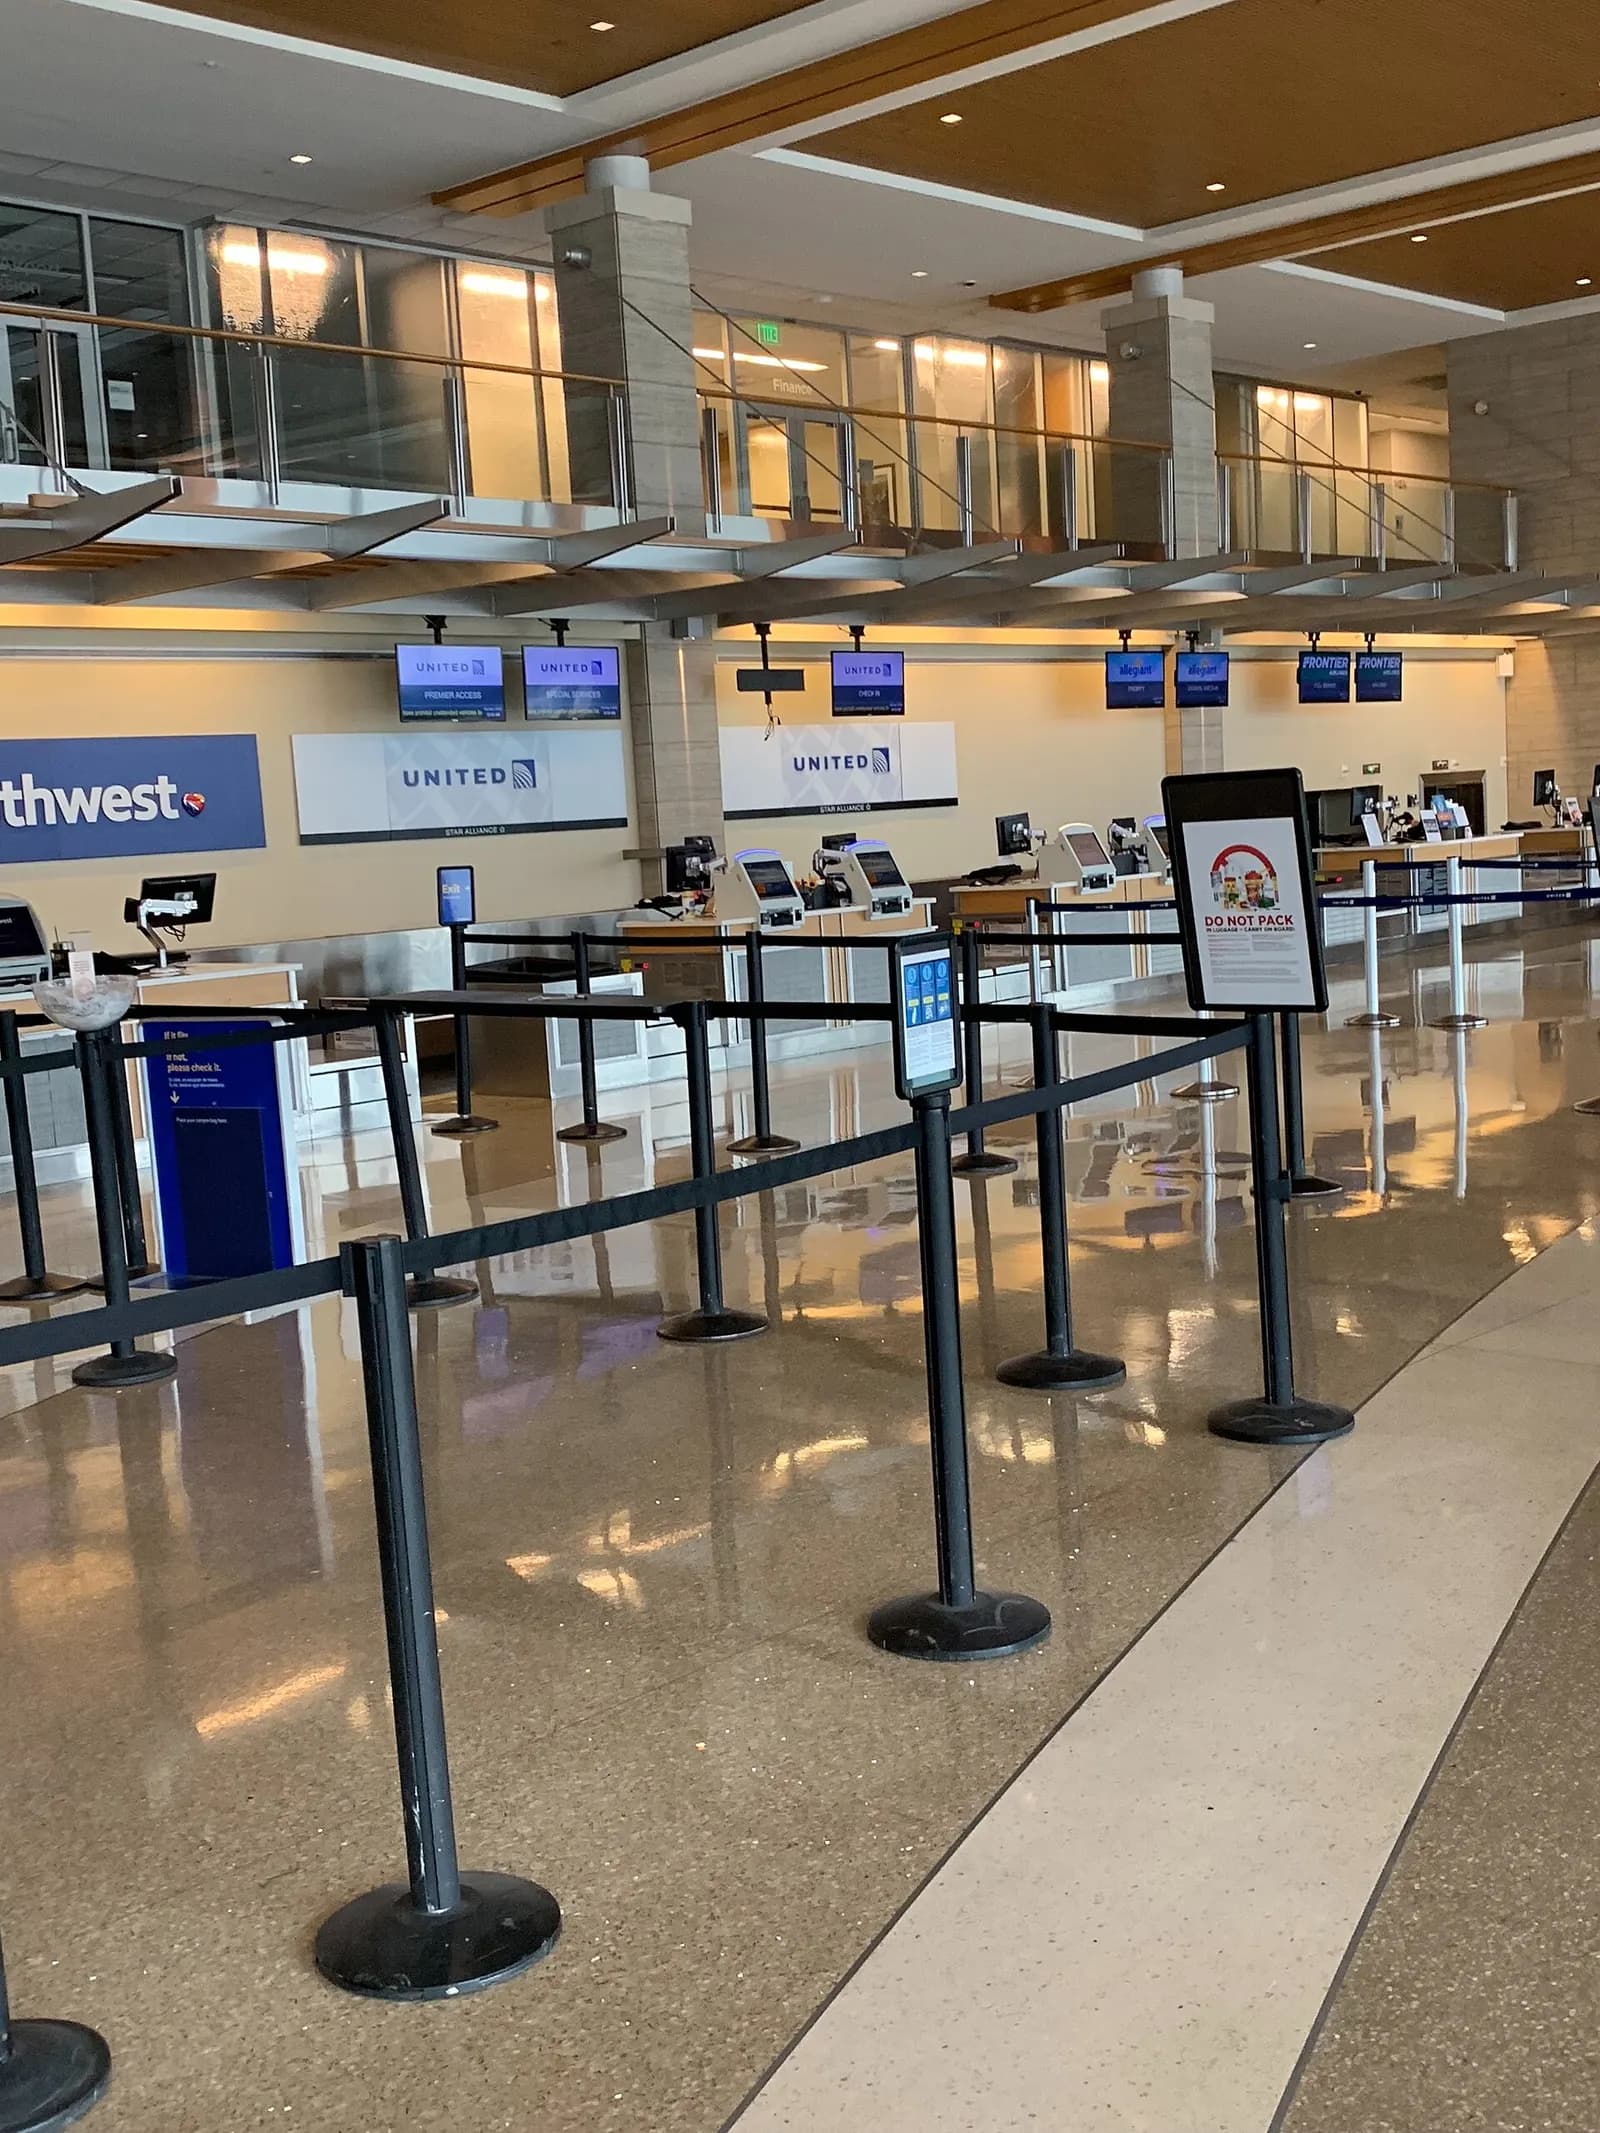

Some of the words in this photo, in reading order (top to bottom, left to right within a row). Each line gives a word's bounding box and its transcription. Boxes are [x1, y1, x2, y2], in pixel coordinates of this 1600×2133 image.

[416, 663, 469, 672] UNITED
[540, 664, 588, 672] UNITED
[1302, 656, 1349, 669] FRONTIER
[1359, 657, 1401, 669] FRONTIER
[844, 666, 881, 674] UNITED
[1120, 664, 1152, 677] allegiant
[424, 691, 454, 699] PREMIER
[456, 691, 482, 699] ACCESS
[793, 754, 868, 771] UNITED
[403, 768, 506, 787] UNITED
[0, 773, 180, 827] thwest
[837, 804, 865, 812] ALLIANCE
[445, 828, 463, 836] STAR
[465, 826, 497, 834] ALLIANCE
[1205, 916, 1223, 926] DO
[1227, 915, 1254, 926] NOT
[1258, 914, 1294, 925] PACK
[167, 1063, 190, 1073] please
[191, 1062, 213, 1072] check
